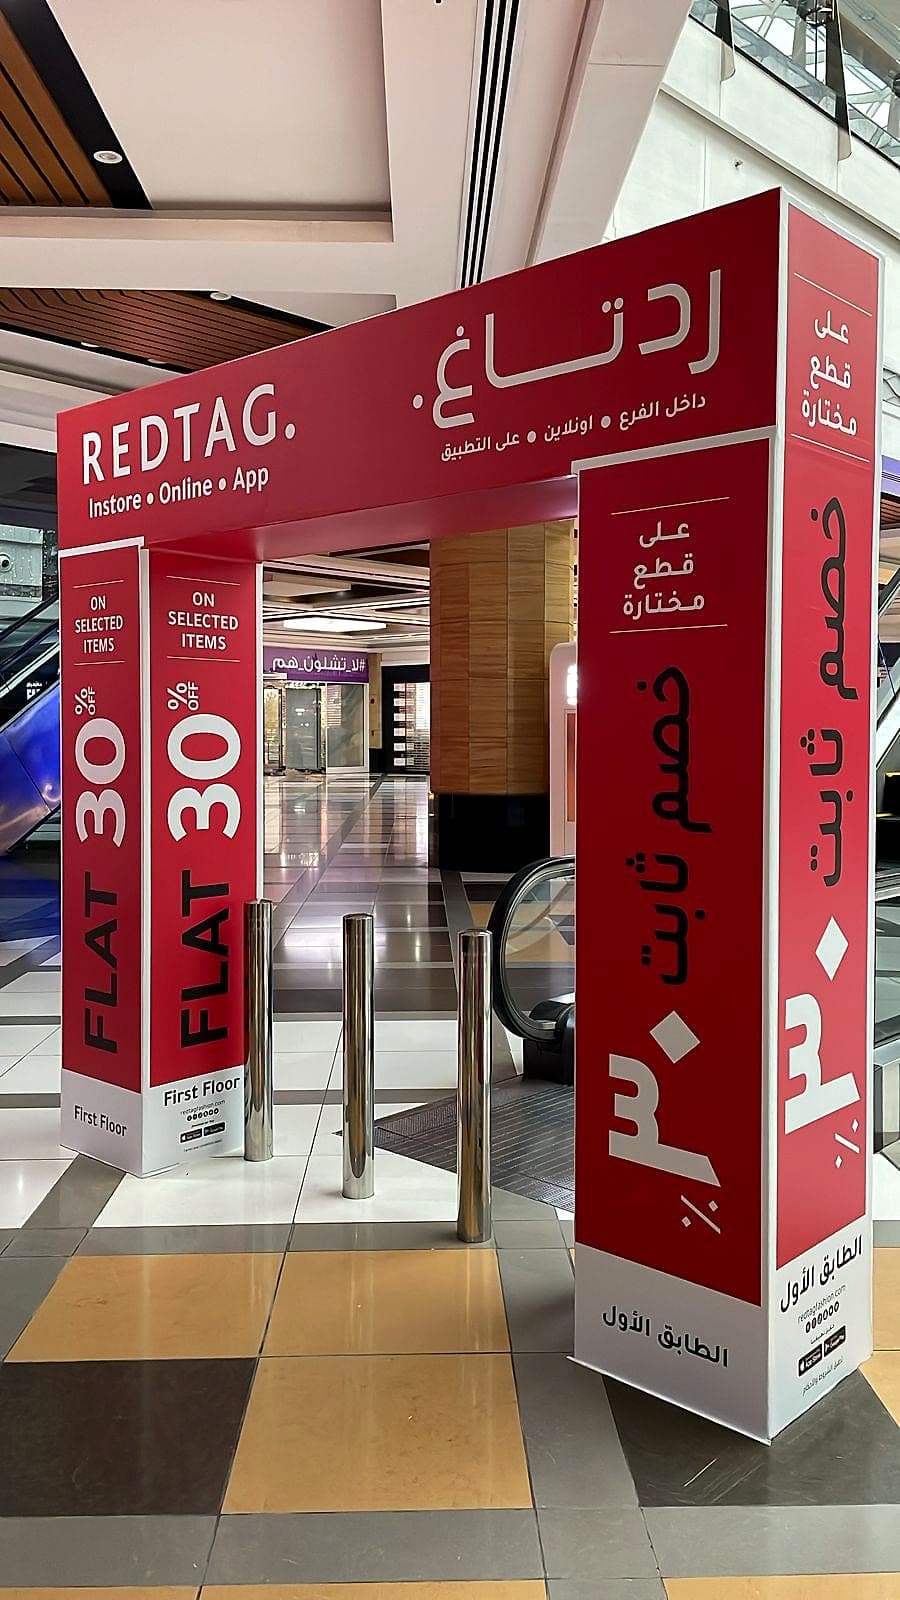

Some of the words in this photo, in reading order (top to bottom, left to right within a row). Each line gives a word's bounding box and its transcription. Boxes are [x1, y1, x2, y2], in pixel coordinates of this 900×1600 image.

[814, 310, 849, 344] على
[809, 355, 852, 390] قطع
[619, 400, 660, 431] الفرع
[665, 393, 706, 418] داخل
[801, 389, 857, 436] مختارة
[495, 431, 520, 452] على
[543, 415, 593, 442] اونلاين
[440, 436, 492, 462] التطبيق
[88, 492, 142, 519] Instore
[159, 476, 212, 504] Online
[232, 466, 269, 495] App
[639, 520, 690, 548] على
[633, 552, 694, 590] قطع
[90, 595, 106, 611] ON
[192, 591, 215, 607] ON
[623, 590, 705, 620] مختارة
[810, 496, 859, 700] خصم
[74, 615, 124, 634] SELECTED
[168, 611, 239, 631] SELECTED
[83, 637, 115, 654] ITEMS
[181, 633, 227, 651] ITEMS
[87, 686, 96, 716] OFF
[187, 680, 199, 711] OFF
[636, 666, 713, 833] خصم
[799, 728, 854, 888] ثابت
[625, 852, 706, 985] ثابت
[84, 871, 118, 1054] FLAT
[180, 869, 230, 1048] FLAT
[164, 1085, 199, 1107] First
[202, 1077, 241, 1097] Floor
[74, 1104, 98, 1128] First
[100, 1113, 127, 1137] Floor
[819, 1234, 862, 1286] الطابق
[780, 1264, 814, 1313] الأول
[602, 1305, 650, 1337] الأول
[657, 1323, 728, 1368] الطابق
